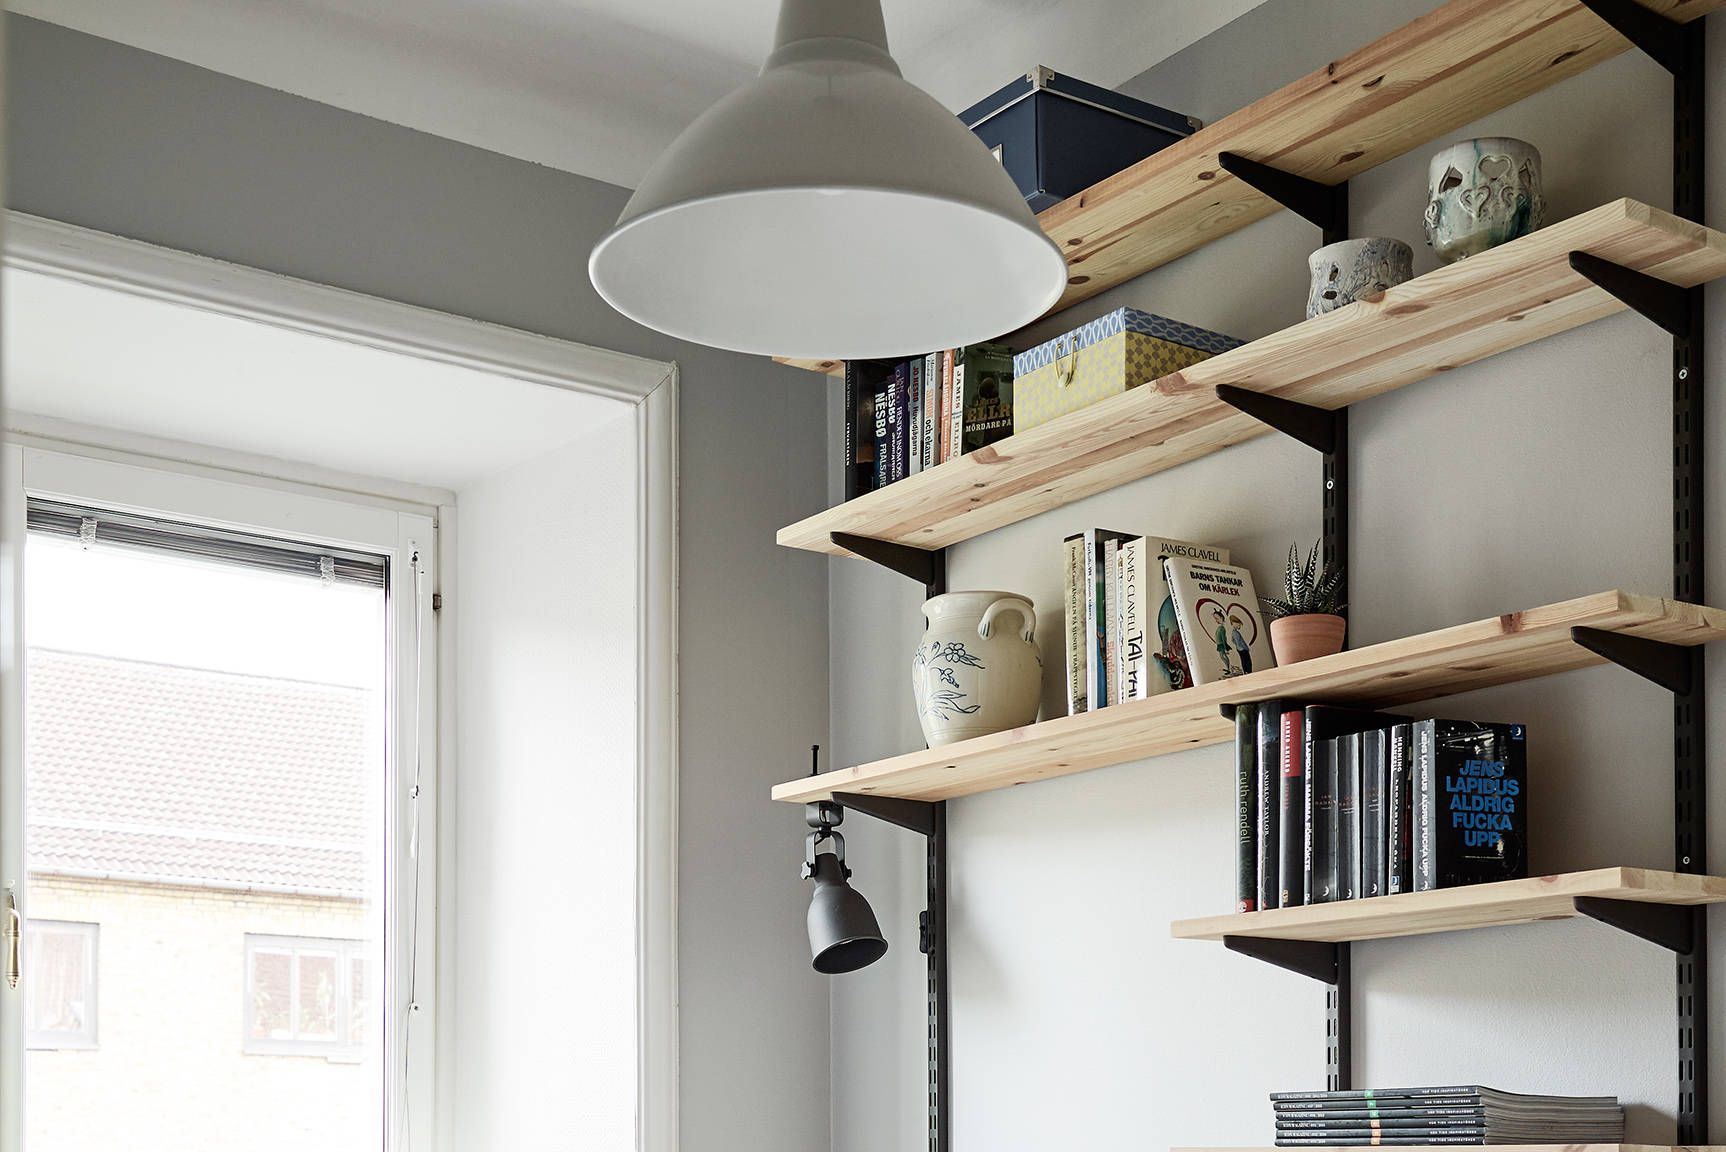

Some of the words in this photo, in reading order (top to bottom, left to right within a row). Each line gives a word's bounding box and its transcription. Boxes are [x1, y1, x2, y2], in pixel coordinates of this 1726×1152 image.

[875, 392, 888, 437] NESBØ
[924, 419, 933, 435] och
[924, 436, 933, 466] ekarna
[1161, 542, 1187, 557] JAMES
[1187, 547, 1222, 562] CLAVELL
[1126, 545, 1136, 584] JAMES
[1189, 571, 1215, 583] BARNS
[1214, 575, 1243, 587] TANKAR
[1198, 582, 1211, 592] OM
[1211, 583, 1241, 597] KÄRLEK
[1127, 584, 1136, 635] CLAVELL
[1304, 718, 1312, 742] JENS
[1421, 730, 1429, 754] JENS
[1421, 755, 1429, 791] LAPIDUS
[1459, 759, 1505, 777] JENS
[1239, 771, 1250, 799] ruth
[1446, 776, 1520, 796] LAPIDUS
[1421, 793, 1429, 826] ALDRIG
[1449, 794, 1515, 813] ALDRIG
[1239, 799, 1250, 845] rendell
[1452, 812, 1513, 831] FUCKA
[1464, 830, 1501, 848] UPP
